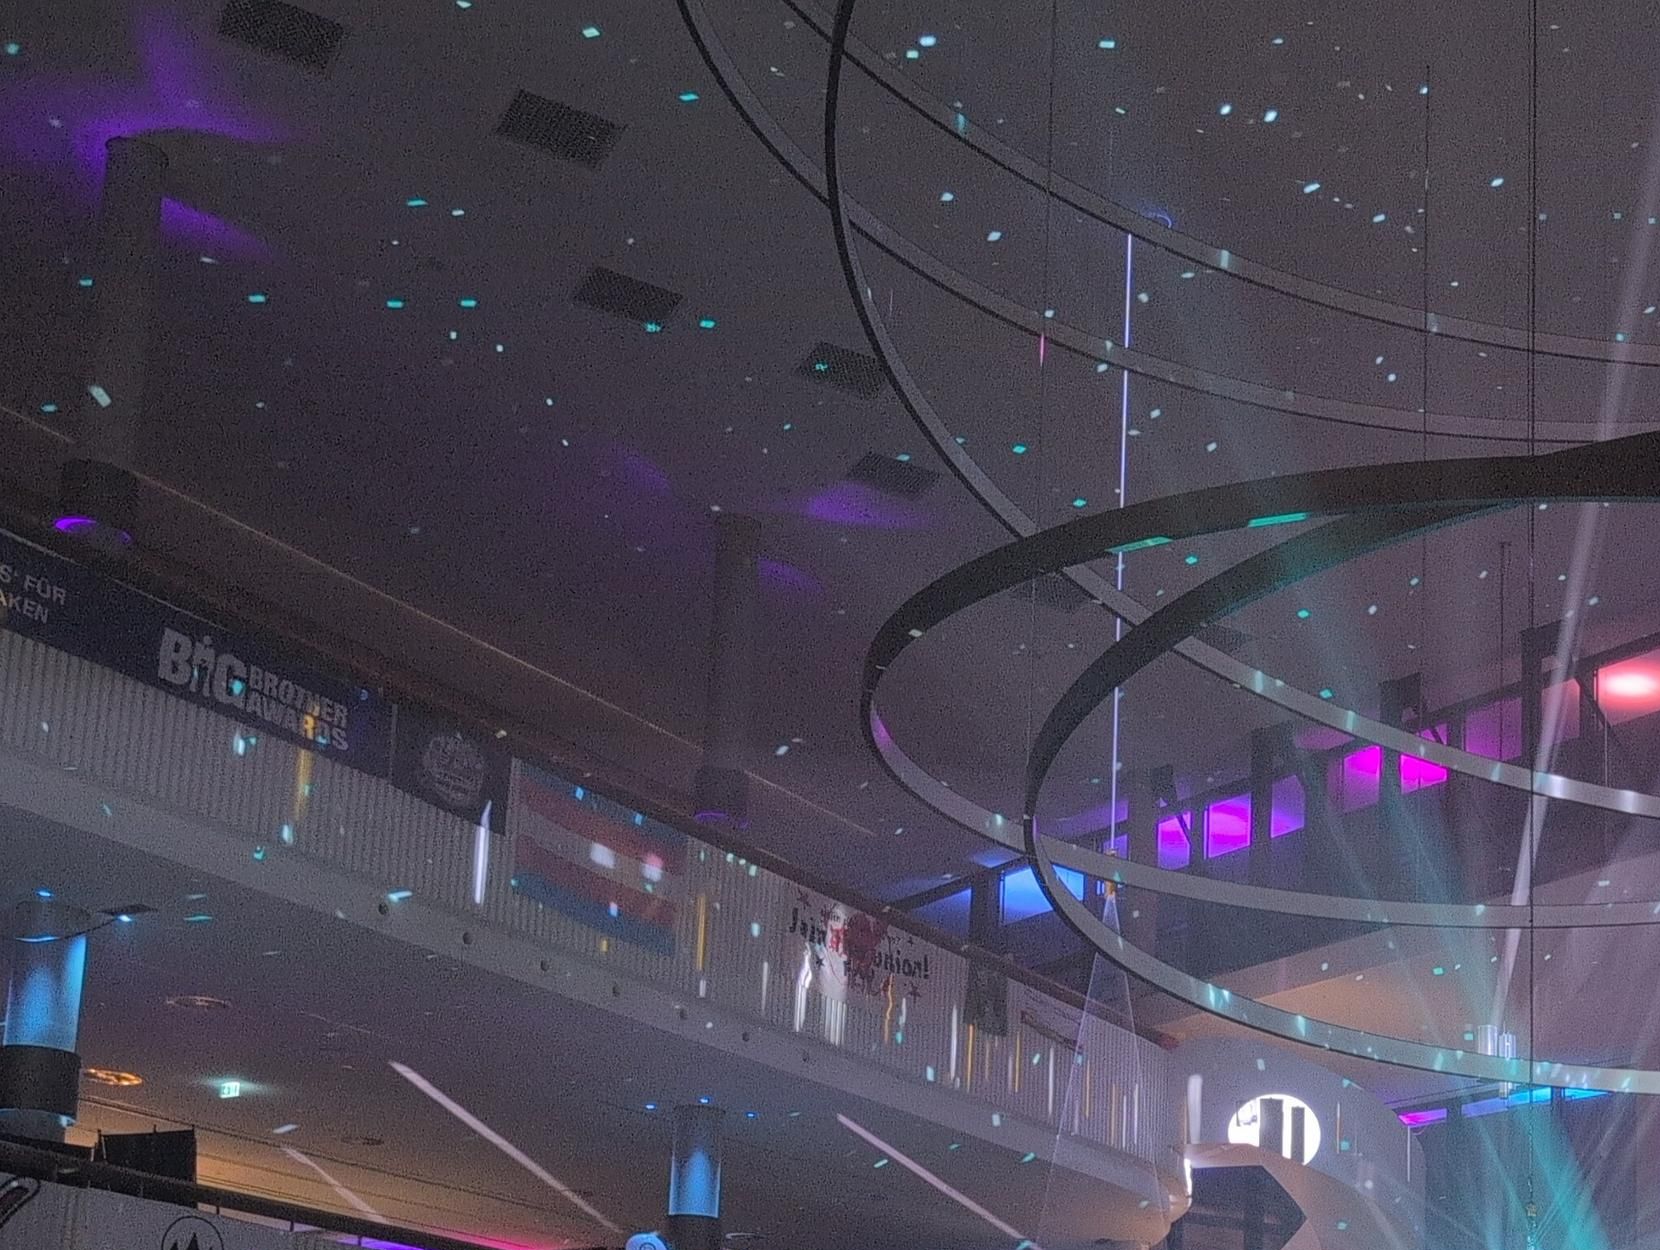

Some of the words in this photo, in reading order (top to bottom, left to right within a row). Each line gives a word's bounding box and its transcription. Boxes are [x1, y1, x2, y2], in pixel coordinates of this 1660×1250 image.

[23, 574, 67, 606] FÜR
[246, 690, 349, 751] AWARDS
[249, 665, 348, 728] BROTHER
